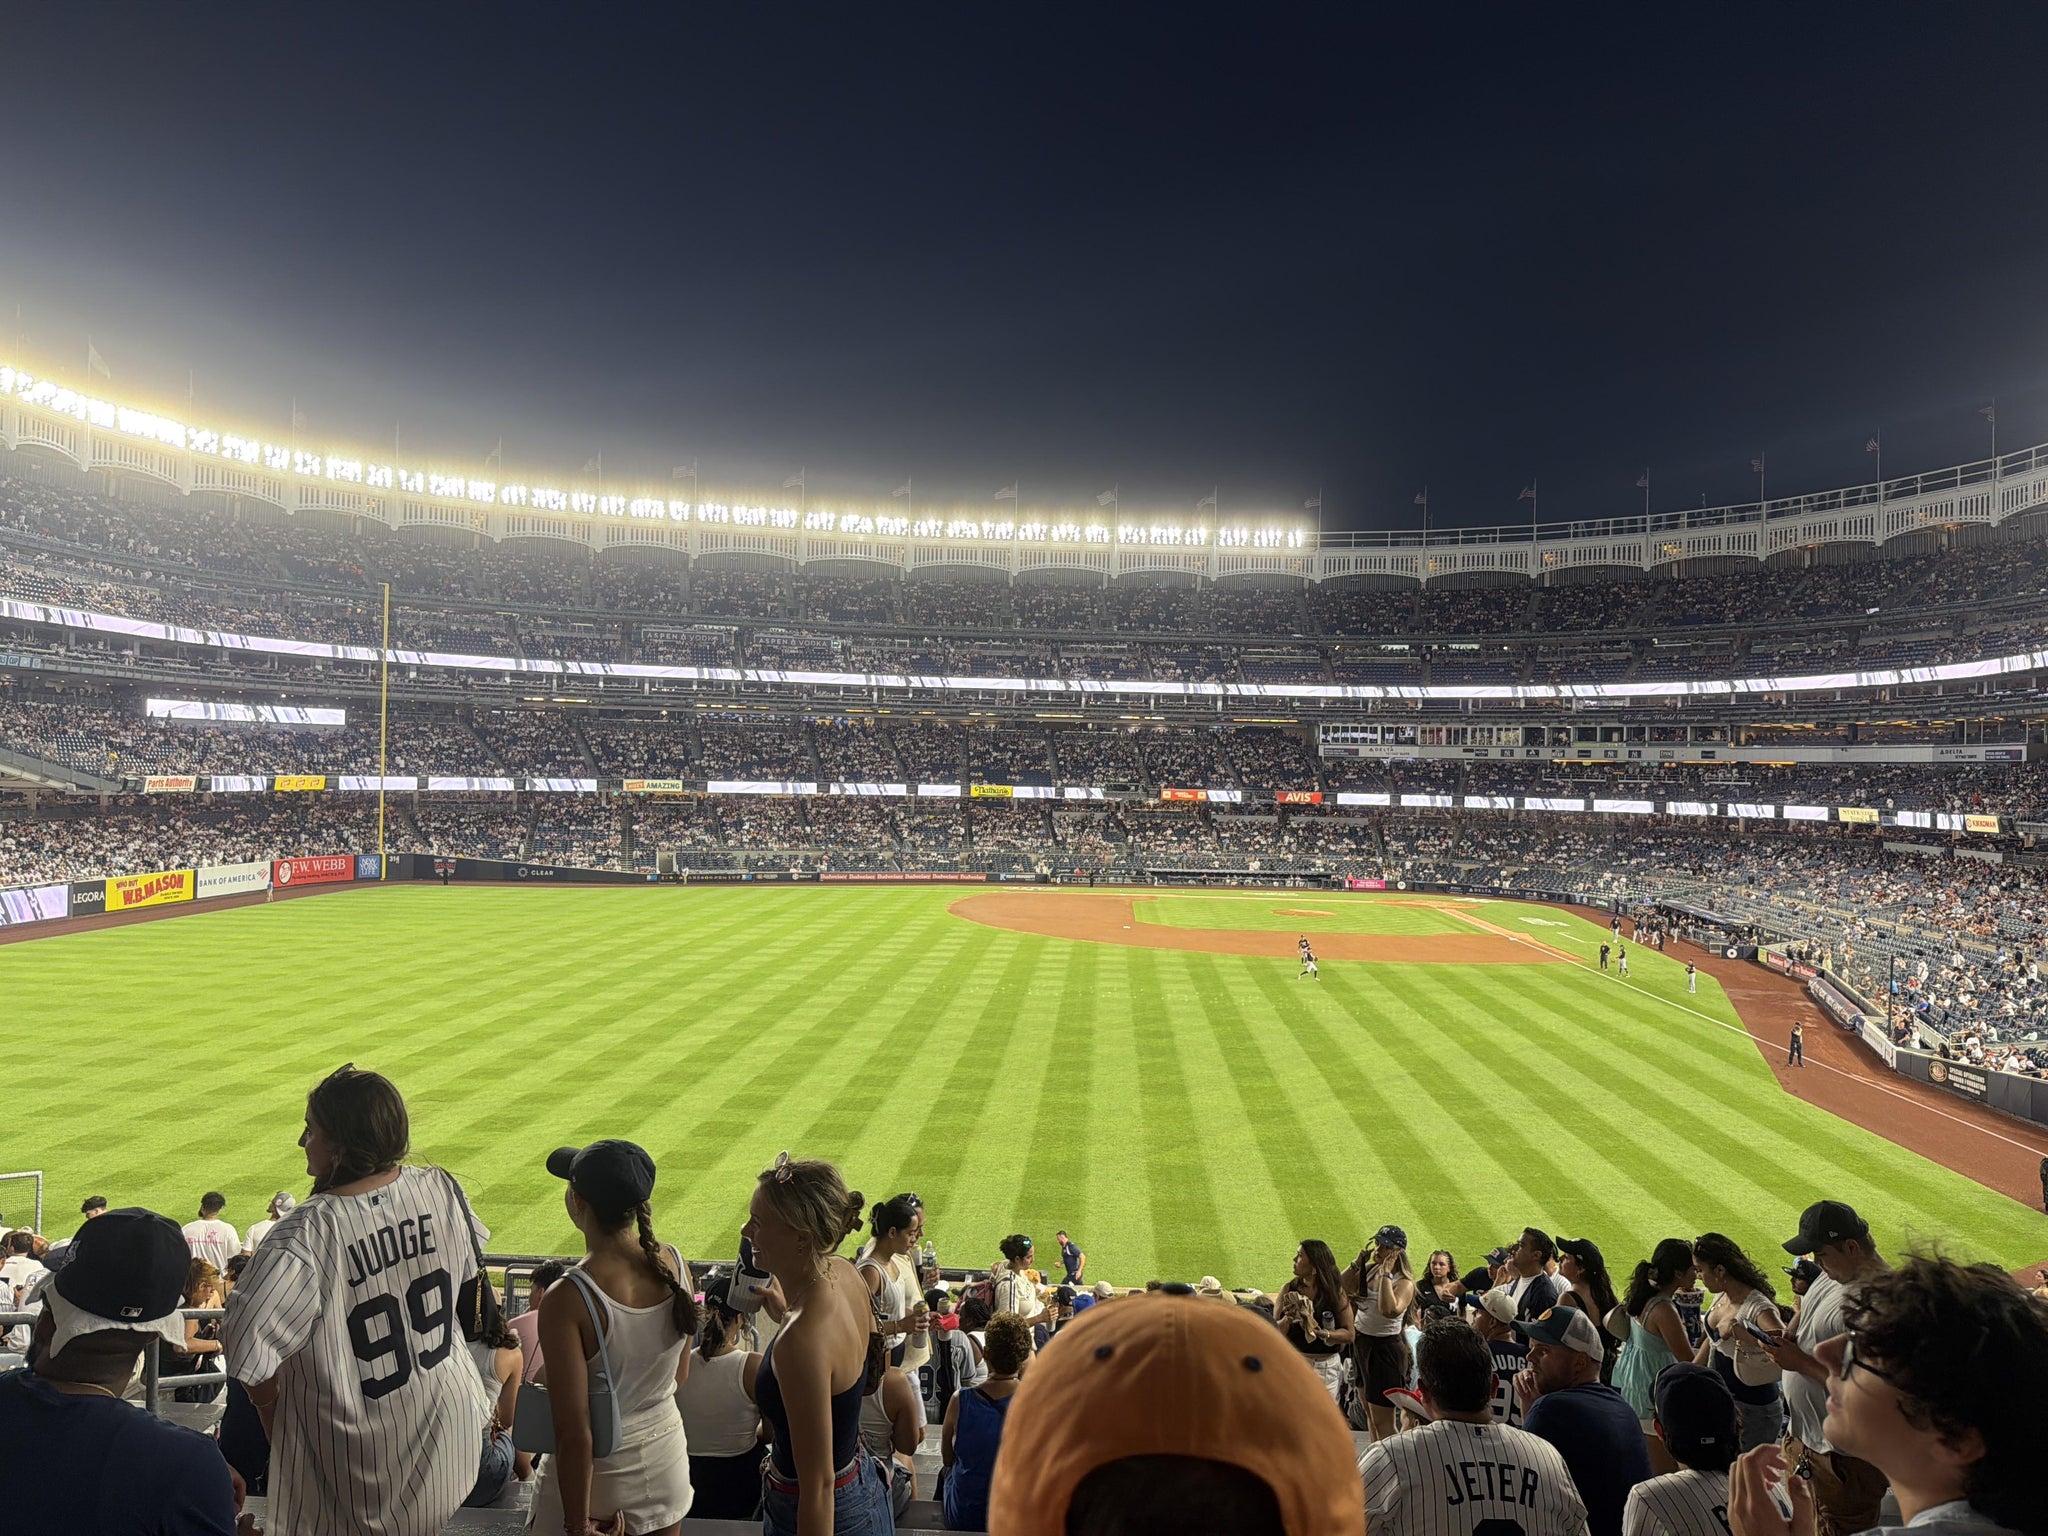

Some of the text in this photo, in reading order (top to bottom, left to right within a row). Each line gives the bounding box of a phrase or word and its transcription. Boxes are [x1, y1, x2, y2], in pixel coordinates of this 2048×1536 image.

[1286, 792, 1310, 802] AVIS
[313, 859, 346, 871] WEBB
[200, 873, 256, 888] BANK OF AMERICA
[73, 891, 105, 903] LEGORA
[347, 1213, 436, 1288] JUDGE
[346, 1267, 453, 1400] 99
[1491, 1354, 1527, 1372] JUDG
[1446, 1461, 1539, 1509] JETER
